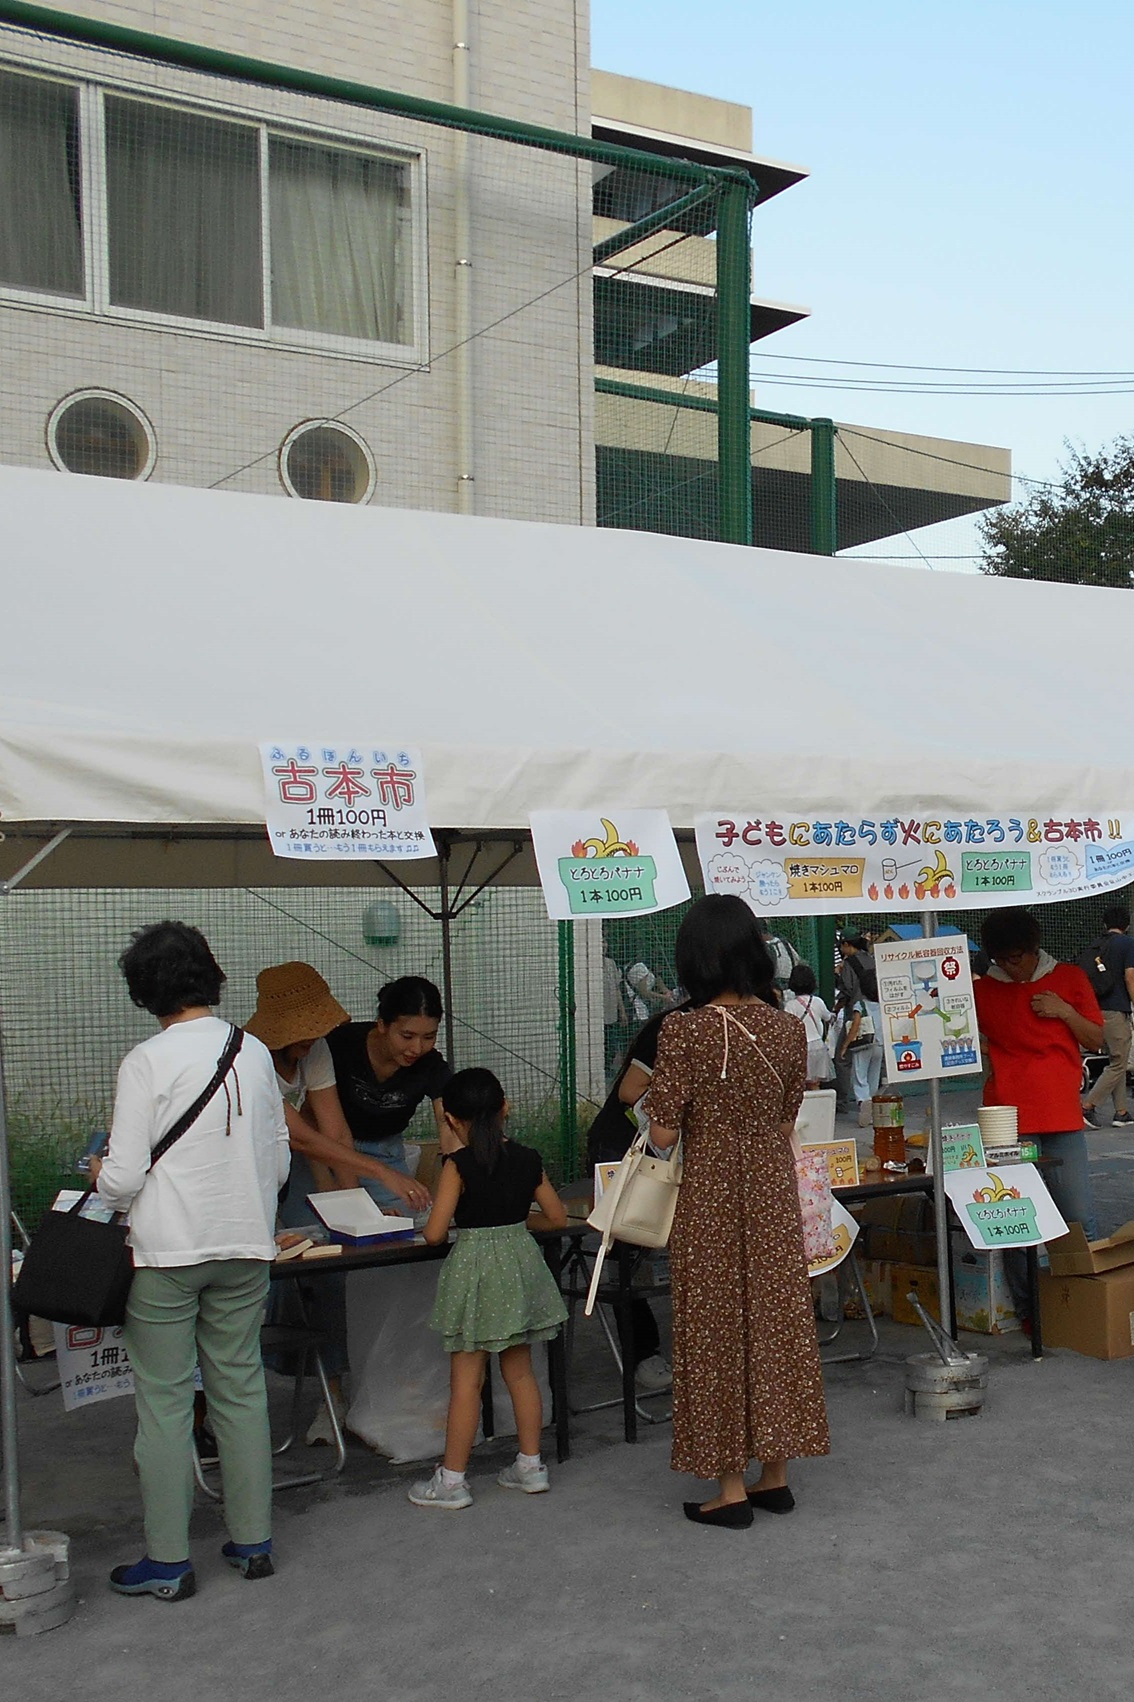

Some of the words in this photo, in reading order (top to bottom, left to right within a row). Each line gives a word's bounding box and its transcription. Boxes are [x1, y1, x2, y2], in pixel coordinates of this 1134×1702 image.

[271, 746, 410, 766] ふるほんいち
[272, 758, 416, 811] 古本市
[306, 807, 387, 827] 1冊100円
[275, 830, 286, 839] or
[789, 864, 859, 877] 焼きマシュマロ
[803, 881, 843, 893] 1本100円
[975, 876, 1015, 886] 1本100円
[580, 887, 642, 903] 1本100円
[880, 946, 964, 962] リサイクル紙容器回収方法
[836, 1155, 852, 1163] 100円
[987, 1225, 1030, 1237] 1本100円
